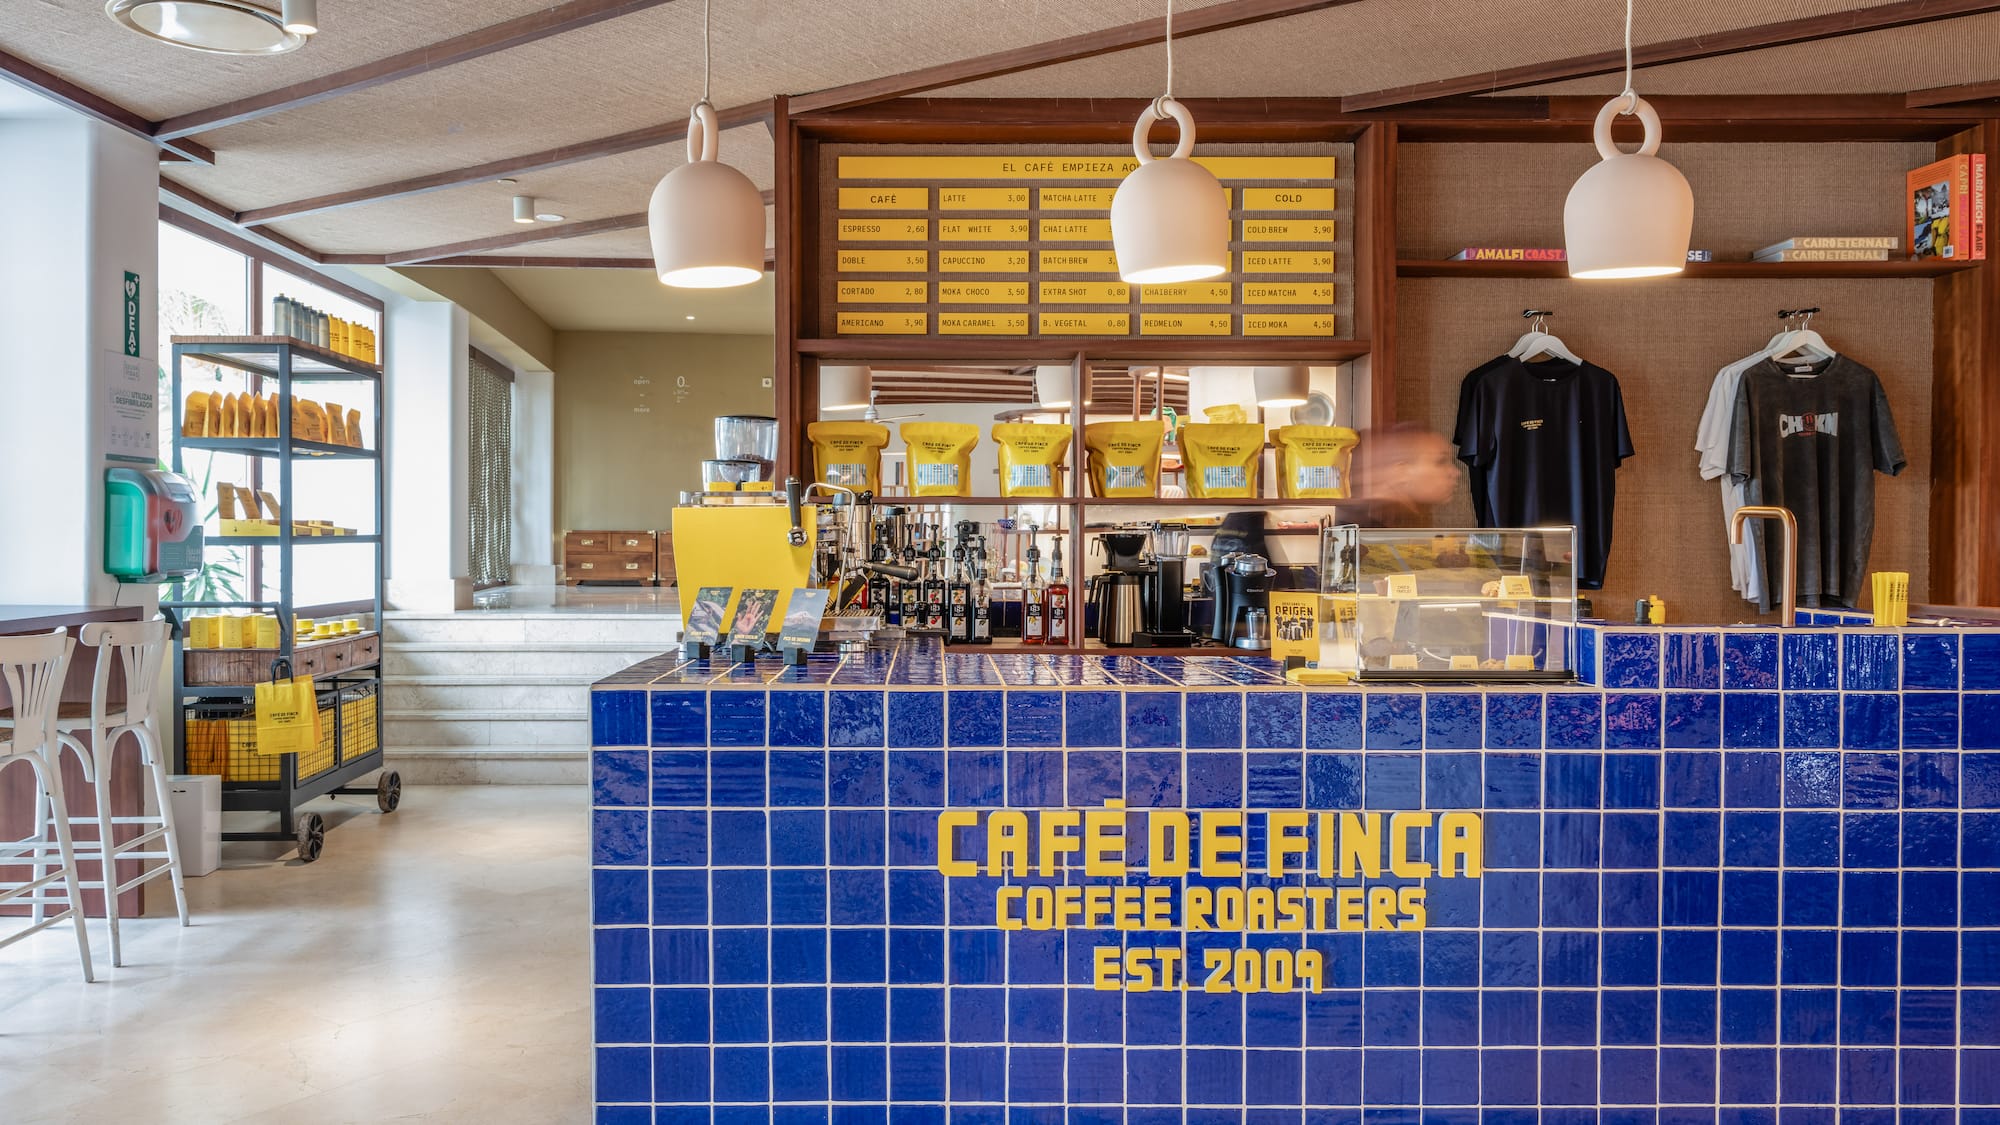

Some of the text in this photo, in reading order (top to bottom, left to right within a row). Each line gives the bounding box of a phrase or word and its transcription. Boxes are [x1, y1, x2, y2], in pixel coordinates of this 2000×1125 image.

[1003, 163, 1016, 172] EL
[1025, 161, 1053, 172] CAFÉ
[1063, 163, 1113, 172] EMPIEZA
[871, 195, 896, 203] CAFÉ
[1975, 163, 1984, 252] MARRAKECH FLAIR
[1803, 239, 1890, 248] CAIRO ETERNAL
[1475, 248, 1562, 260] AMALFI COAST
[1792, 250, 1880, 260] CAIRO ETERNAL
[128, 301, 137, 346] DEA
[1275, 606, 1313, 616] ORIGEN
[937, 799, 1481, 878] CAFÉ DE FINCA
[997, 886, 1426, 931] COFFEE ROASTERS
[1094, 946, 1322, 994] EST. 2009
